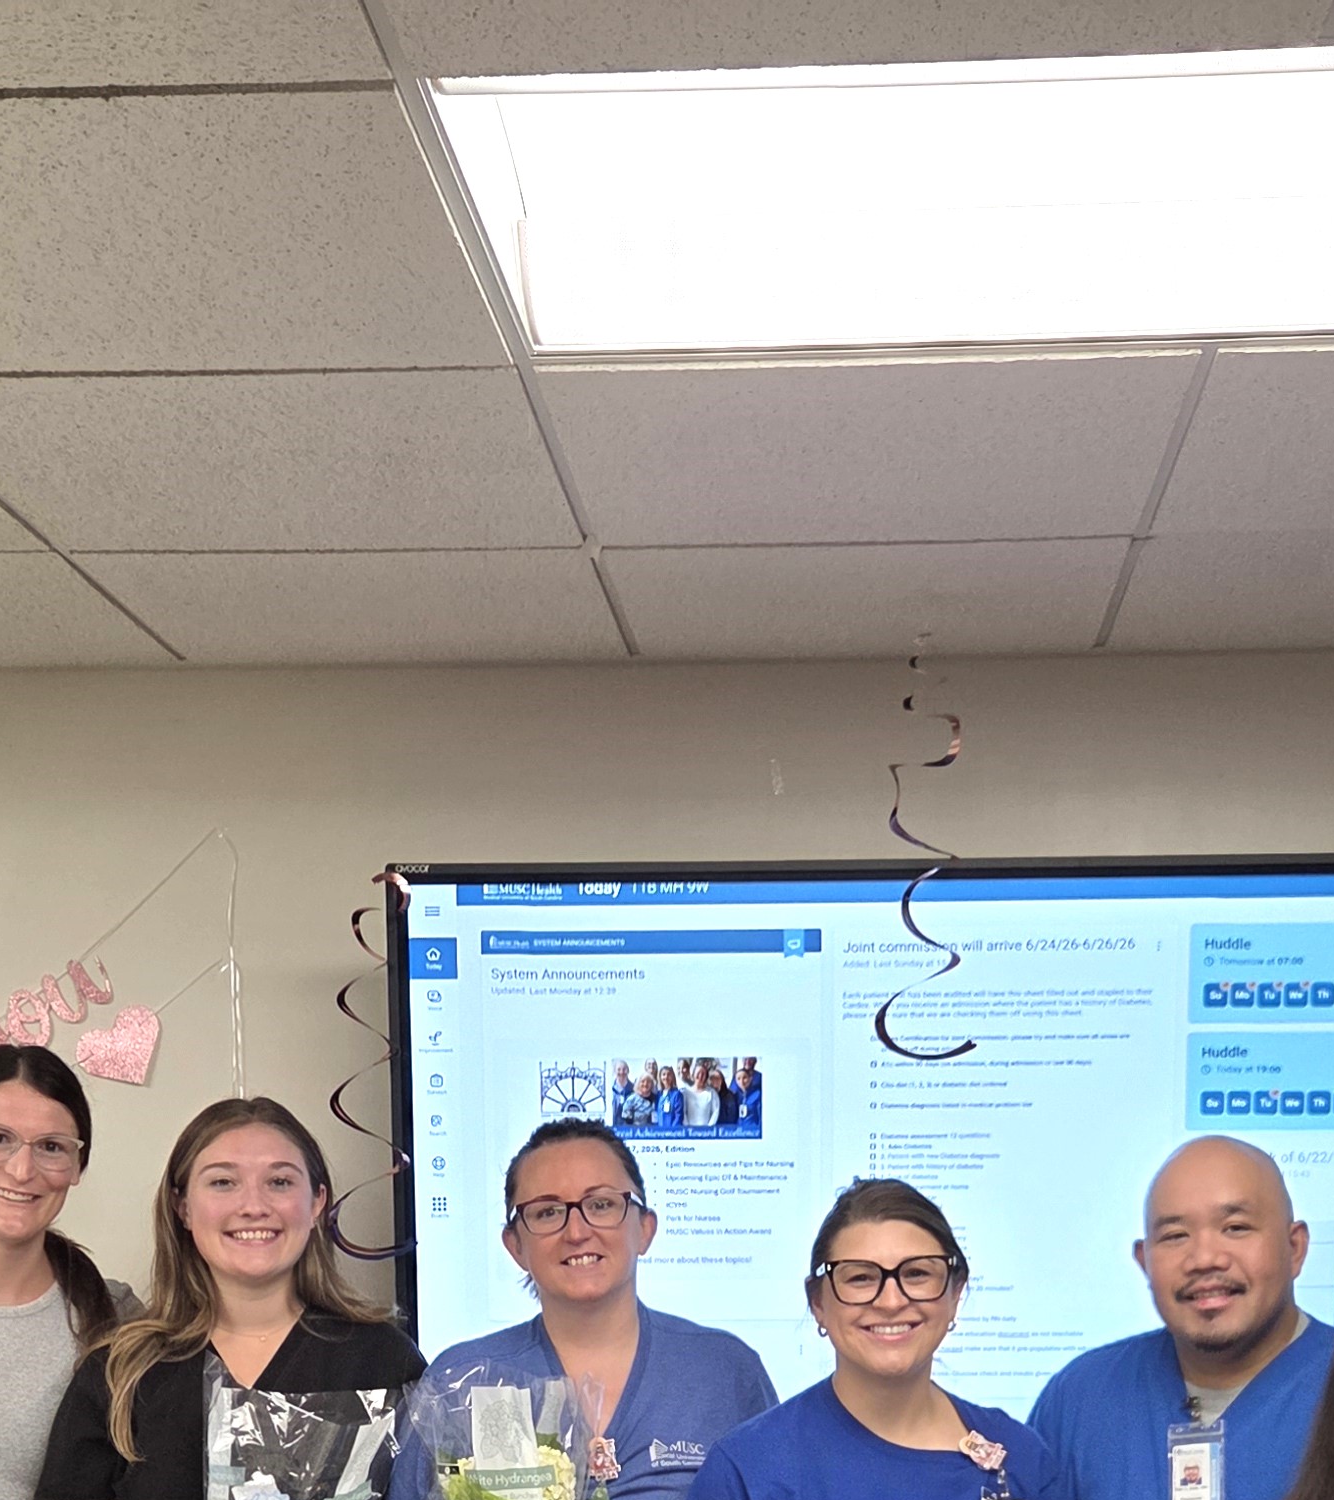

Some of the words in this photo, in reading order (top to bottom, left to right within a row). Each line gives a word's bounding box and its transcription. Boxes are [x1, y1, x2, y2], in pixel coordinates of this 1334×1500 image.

[395, 864, 430, 874] avocor
[498, 884, 530, 894] MUSC
[533, 939, 562, 947] SYSTEM
[562, 938, 626, 947] ANNOUNCEMENTS
[843, 941, 875, 953] Joint
[962, 940, 982, 952] will
[985, 940, 1022, 951] arrive
[1025, 939, 1136, 951] 6/24/26-6/26/26
[1204, 937, 1252, 950] Huddle
[426, 963, 442, 971] Today
[1219, 958, 1264, 966] Tomorrow
[491, 968, 538, 982] System
[542, 968, 646, 981] Announcements
[529, 987, 547, 996] Last
[549, 987, 582, 997] Monday
[584, 988, 592, 996] at
[1209, 991, 1223, 999] Su
[1234, 991, 1250, 999] Mo
[1264, 991, 1276, 999] Tu
[1288, 991, 1304, 999] We
[1316, 990, 1329, 998] Th
[1201, 1046, 1248, 1059] Huddle
[1206, 1099, 1219, 1107] Su
[1231, 1099, 1246, 1107] Mo
[1260, 1098, 1272, 1106] Tu
[1284, 1098, 1300, 1106] We
[1313, 1098, 1324, 1106] Th
[634, 1128, 686, 1137] Achievement
[688, 1127, 716, 1137] Toward
[718, 1127, 760, 1137] Excellence
[1280, 1150, 1294, 1162] of
[670, 1440, 706, 1455] MUSC
[495, 1471, 552, 1488] Hydrangea
